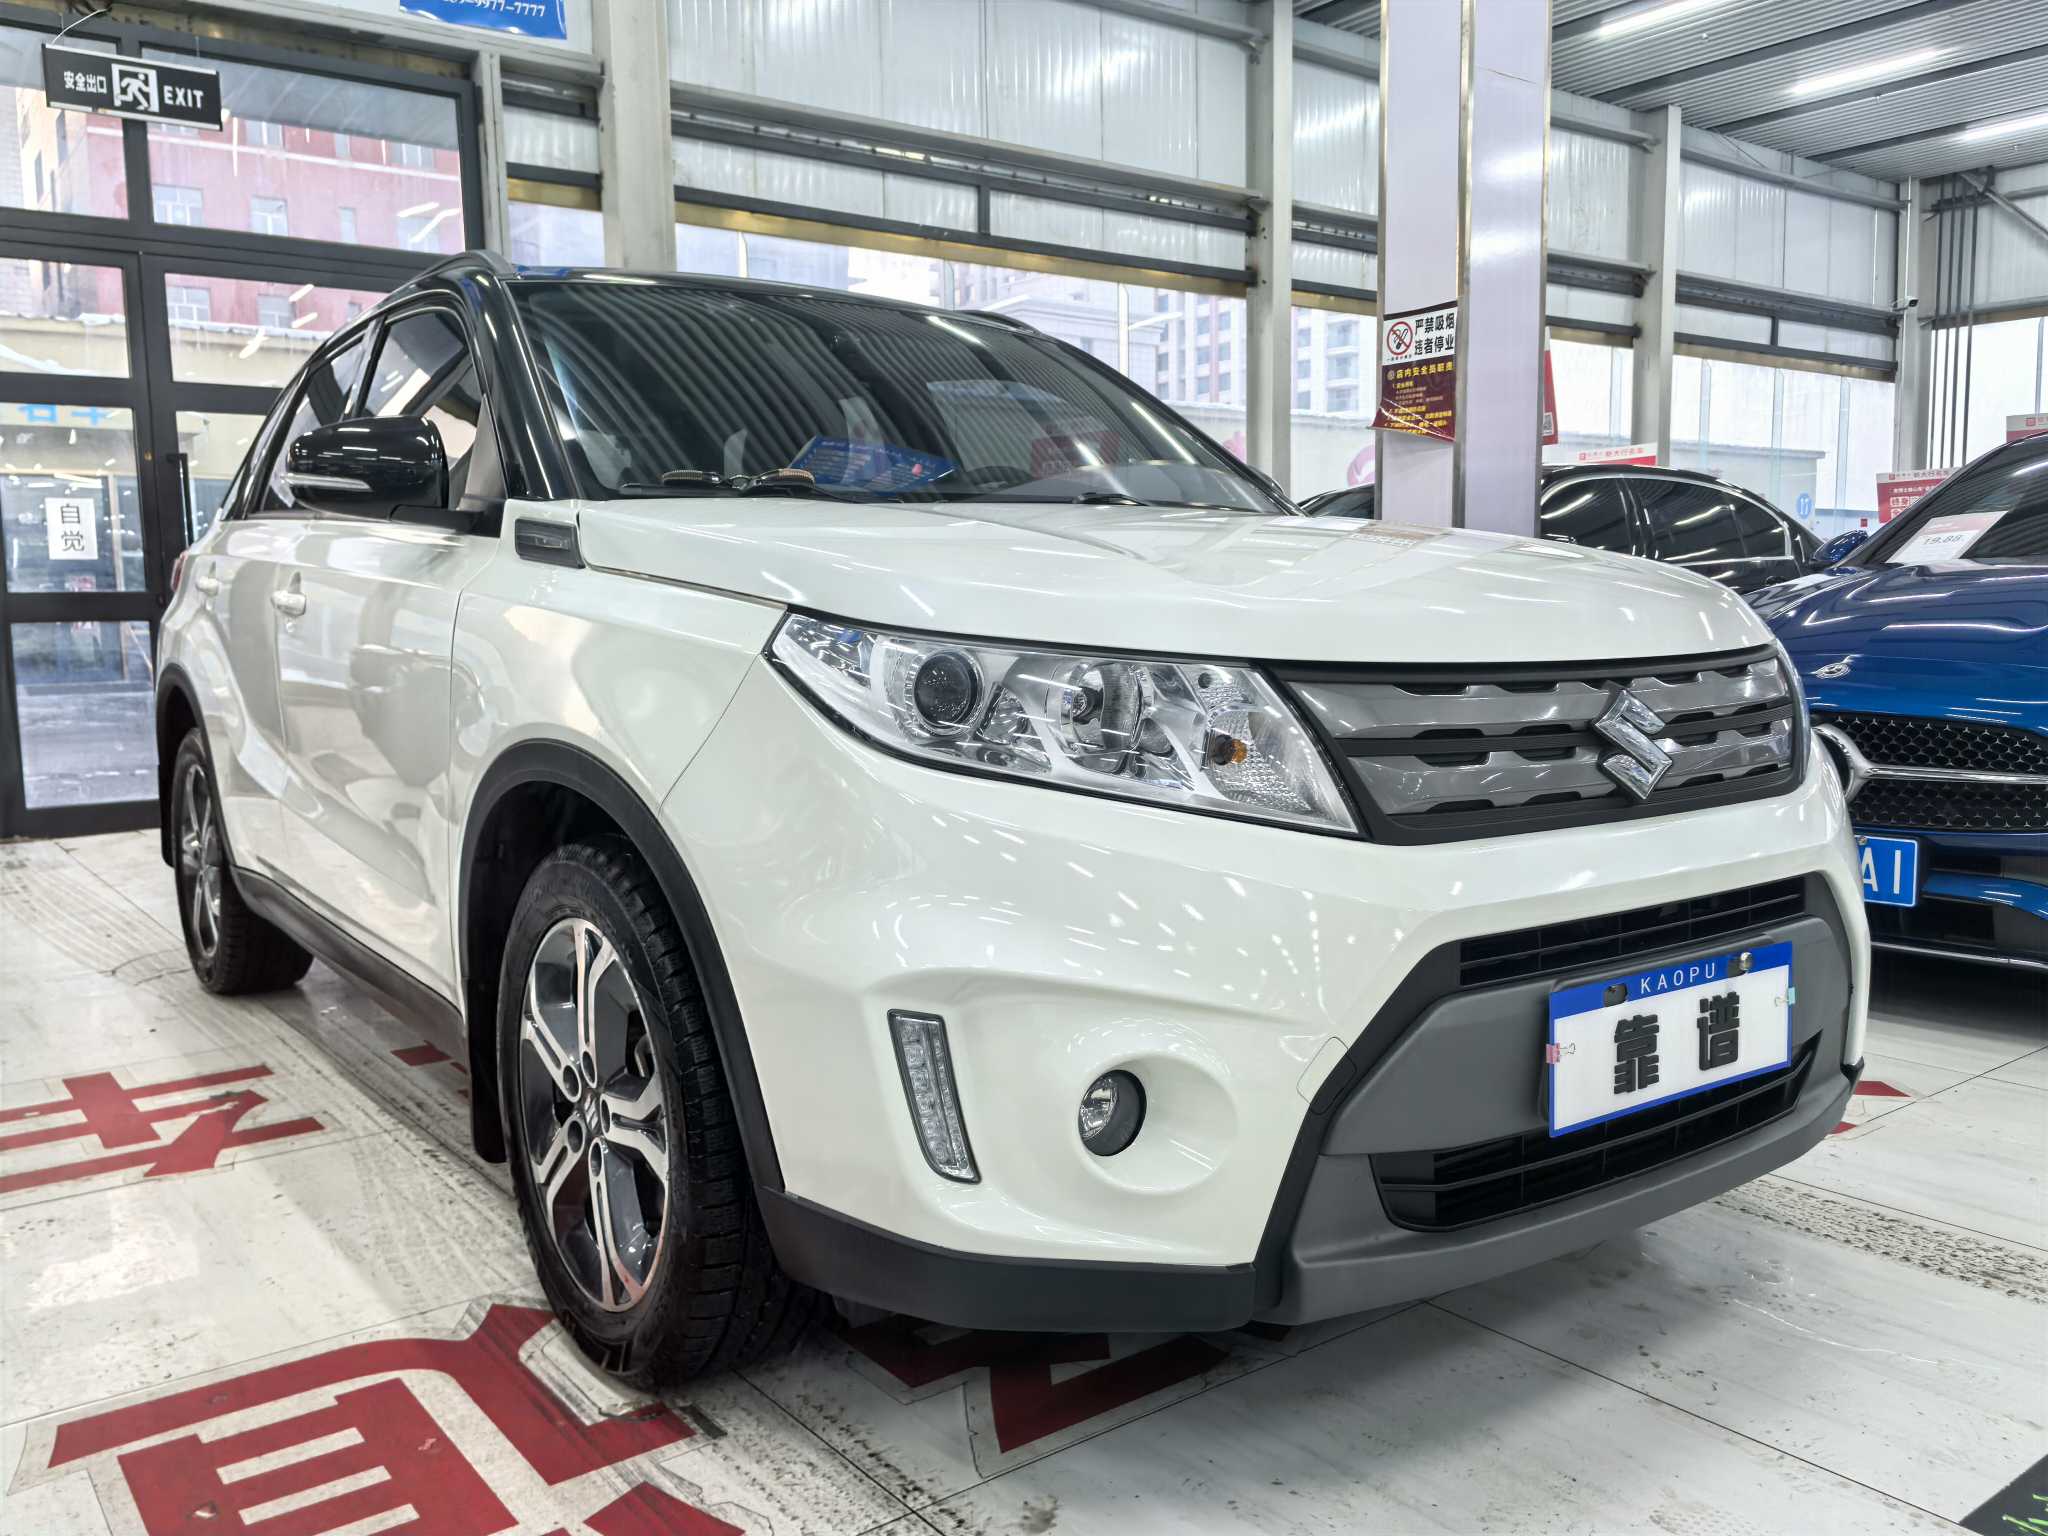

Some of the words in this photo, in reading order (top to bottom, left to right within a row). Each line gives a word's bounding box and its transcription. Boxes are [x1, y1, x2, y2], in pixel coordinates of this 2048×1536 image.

[63, 70, 108, 94] 安全出口
[163, 85, 204, 109] EXIT
[1414, 312, 1455, 336] 严禁吸烟
[1414, 334, 1455, 356] 违者停业
[60, 503, 85, 552] 自觉
[1640, 963, 1716, 994] KAOPU
[1613, 991, 1740, 1095] 靠谱
